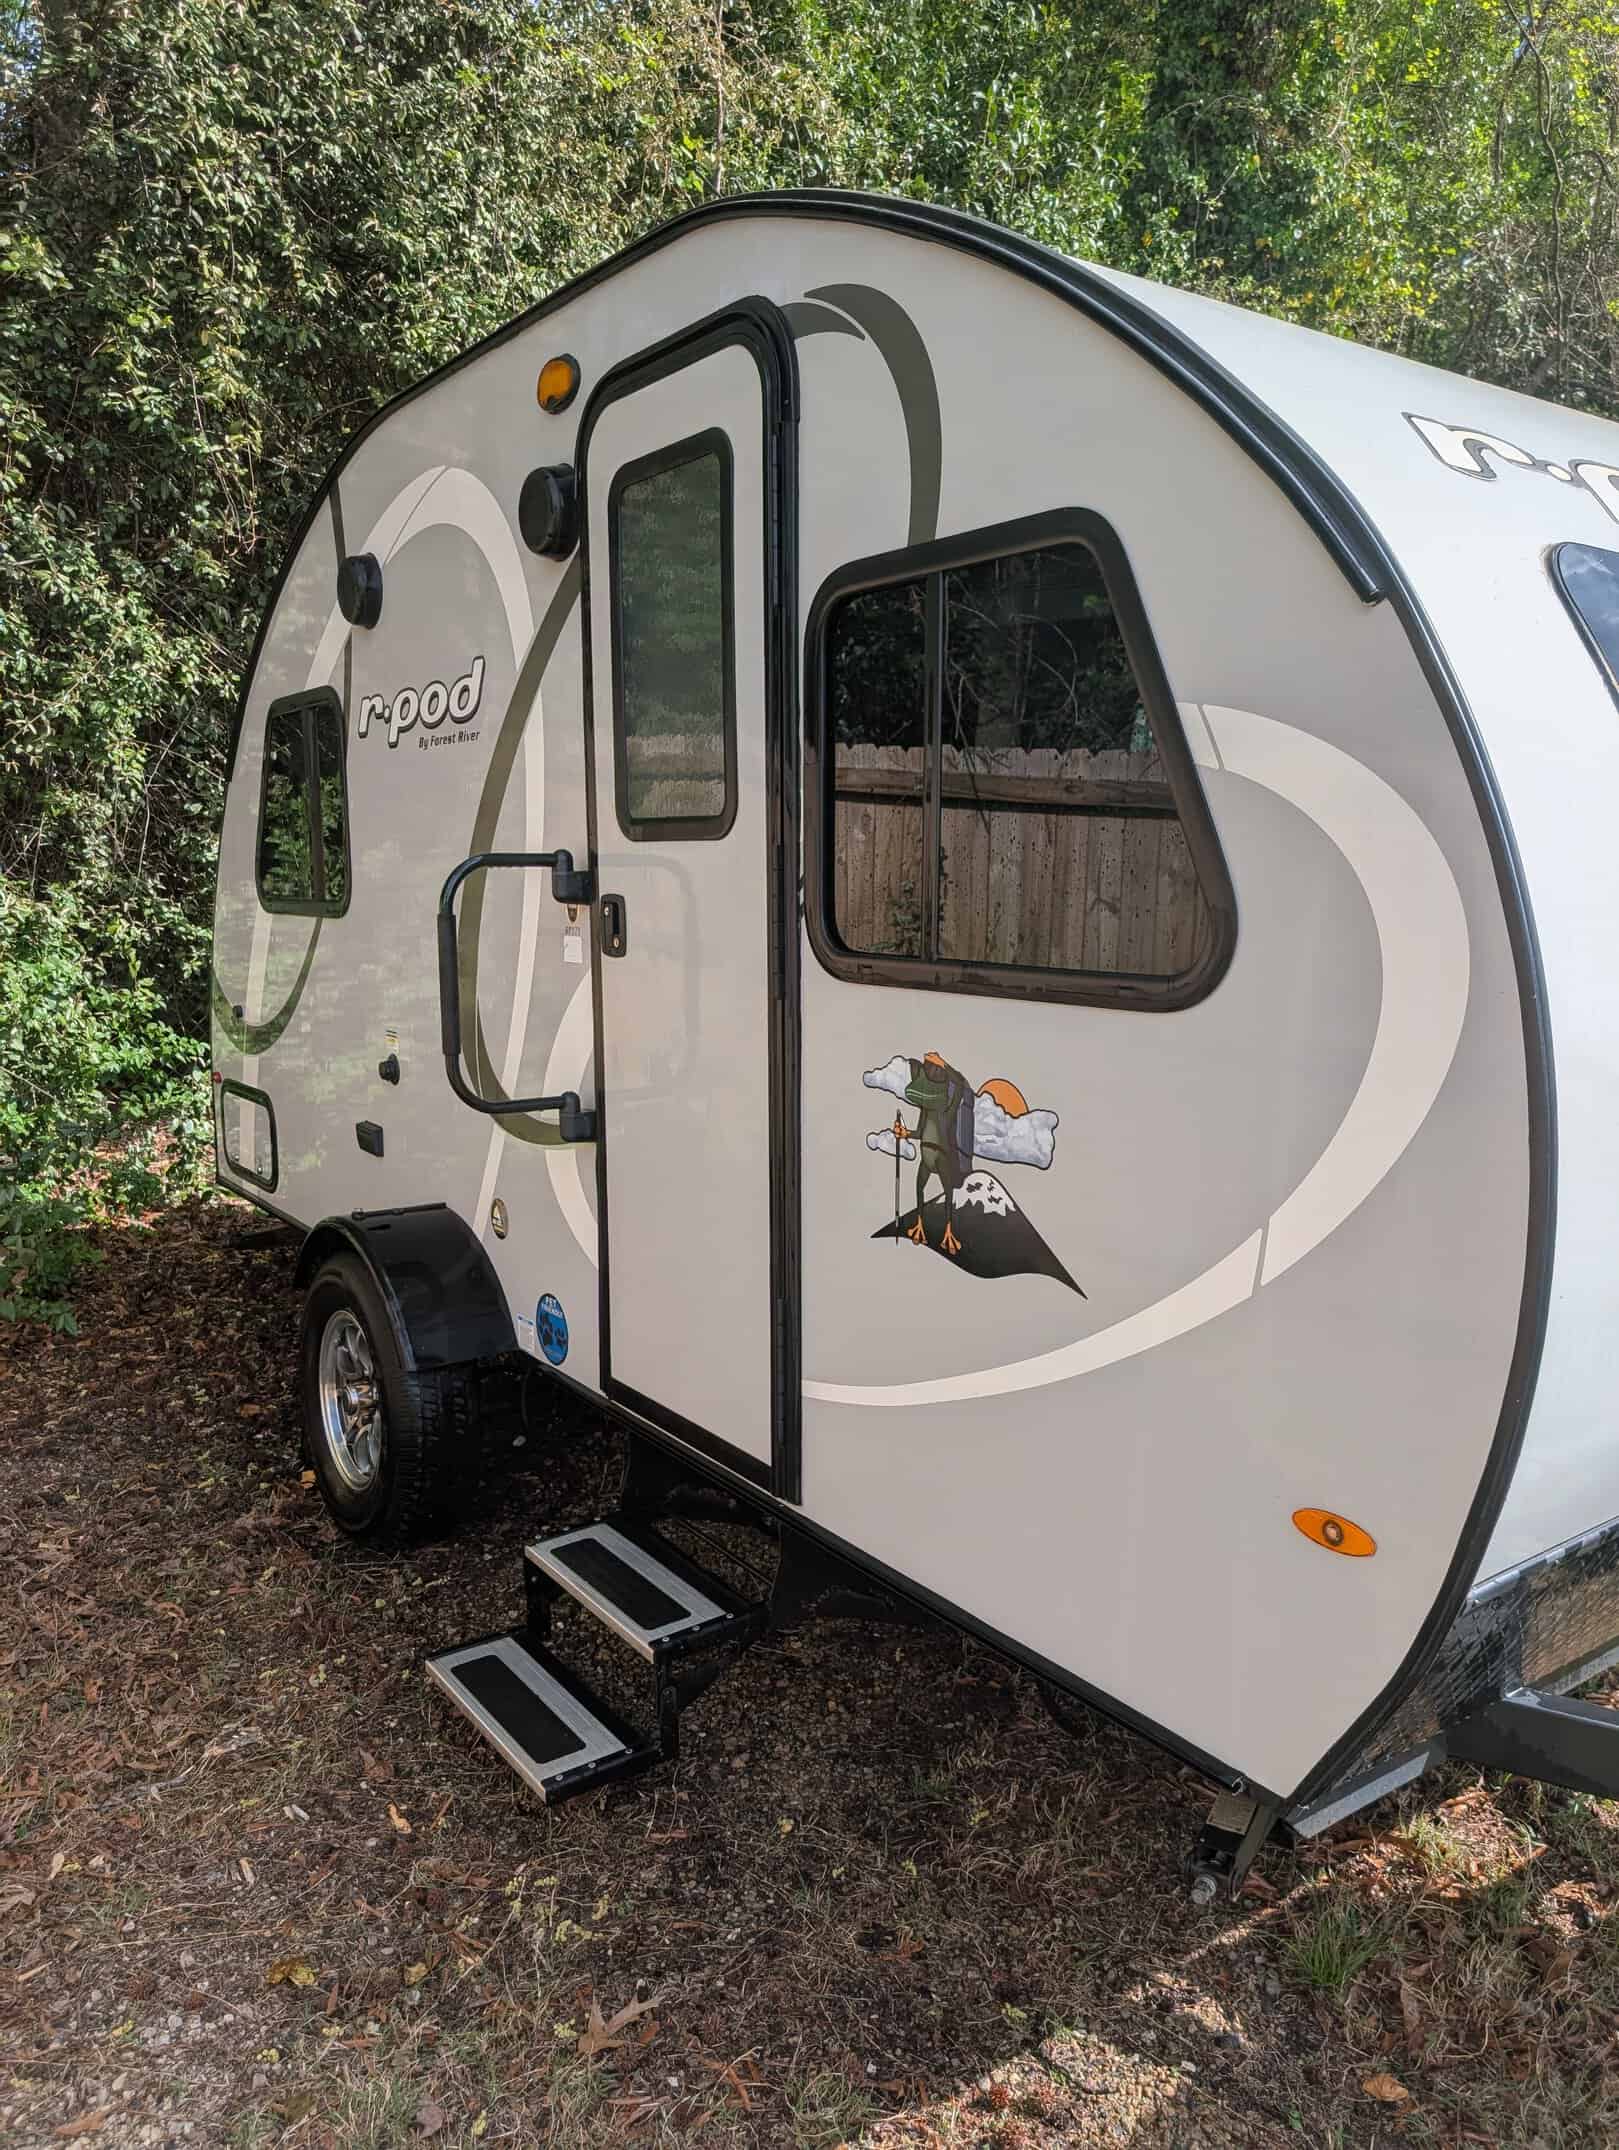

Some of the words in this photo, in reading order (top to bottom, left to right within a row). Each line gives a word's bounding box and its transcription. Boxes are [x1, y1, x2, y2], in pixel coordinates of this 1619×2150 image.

[418, 737, 429, 751] By
[430, 733, 456, 747] Forest
[458, 729, 480, 742] River
